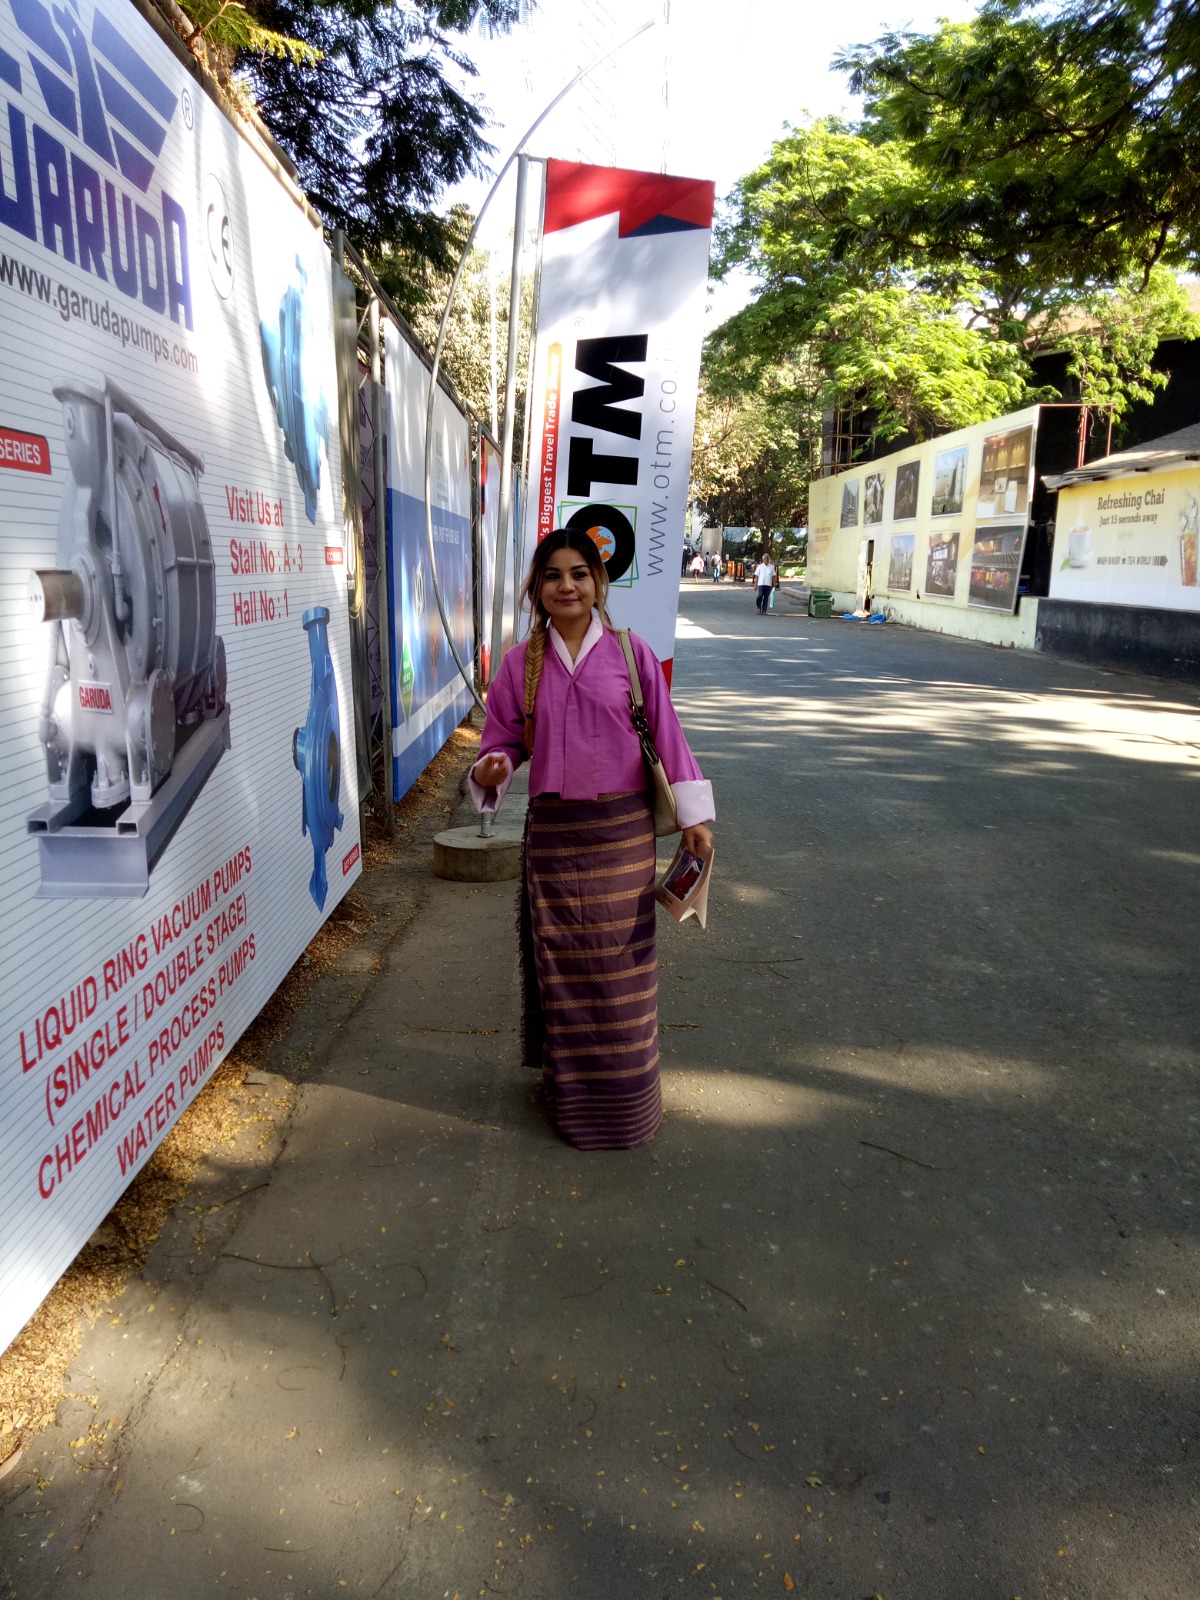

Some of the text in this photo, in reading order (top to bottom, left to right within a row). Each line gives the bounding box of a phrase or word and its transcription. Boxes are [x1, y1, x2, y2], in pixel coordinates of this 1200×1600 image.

[0, 254, 198, 374] www.garudapumps.com
[545, 392, 557, 431] Trade
[0, 437, 41, 466] SERIES
[543, 433, 555, 474] Travel
[565, 334, 649, 584] OTM
[647, 341, 678, 577] www.otm.co.i
[225, 485, 284, 527] Visit Us at
[540, 476, 553, 525] Biggest
[1098, 488, 1165, 510] Refreshing Chai
[1100, 512, 1158, 527] Just 15 seconds away
[230, 538, 257, 575] Stall
[259, 541, 275, 574] No
[284, 543, 291, 572] A
[298, 543, 303, 572] 3
[234, 591, 257, 625] Hall
[260, 590, 275, 623] No
[284, 589, 289, 616] 1
[79, 685, 111, 710] GARUDA
[19, 845, 252, 1074] LIQUID RING VACUUM PUMPS
[46, 1004, 129, 1126] (SINGLE
[143, 941, 204, 1023] DOUBLE
[206, 892, 248, 955] STAGE)
[37, 933, 256, 1200] CHEMICAL PROCESS PUMPS
[117, 1021, 224, 1177] WATER PUMPS
